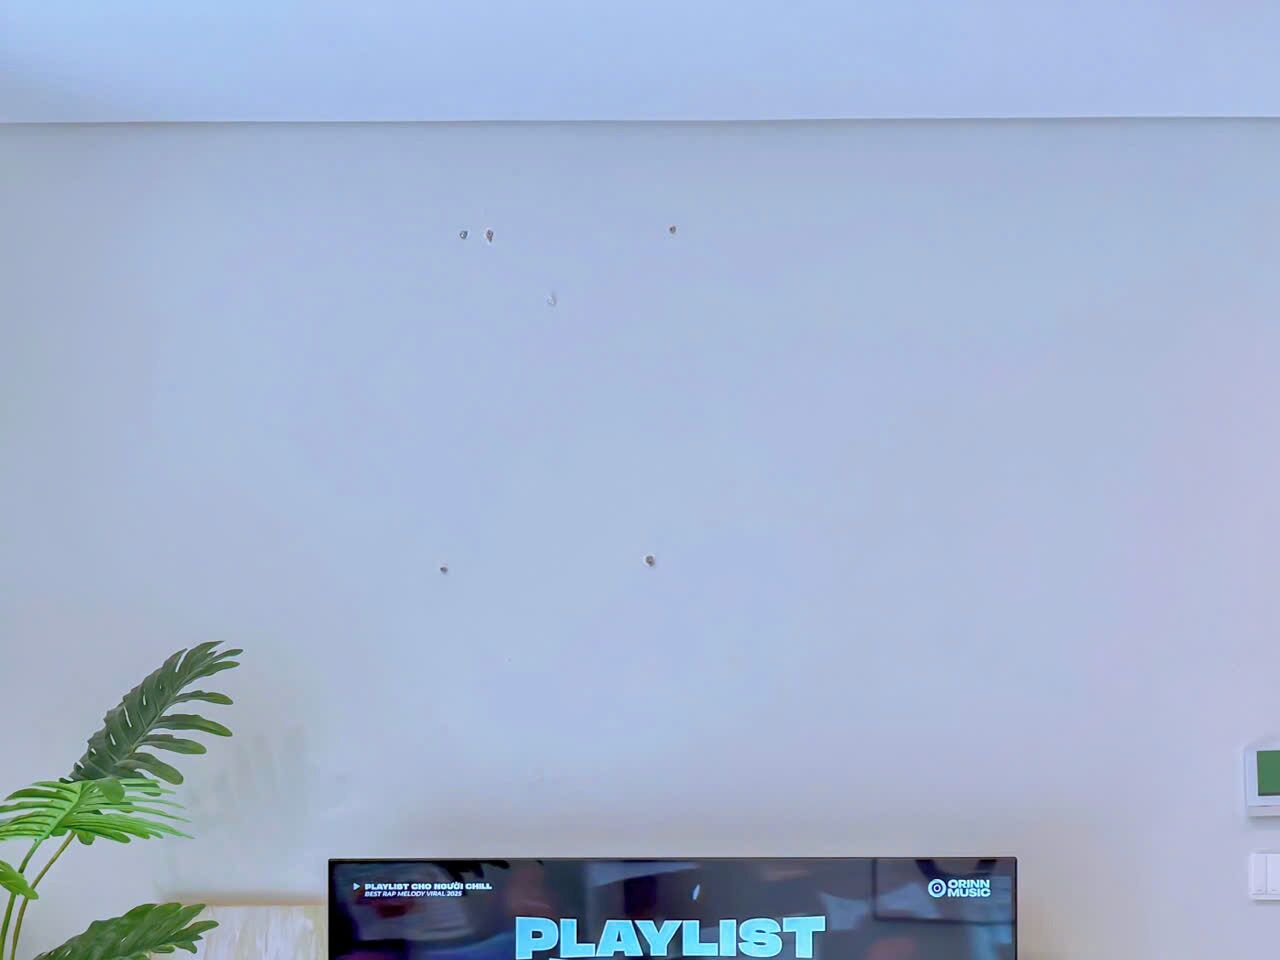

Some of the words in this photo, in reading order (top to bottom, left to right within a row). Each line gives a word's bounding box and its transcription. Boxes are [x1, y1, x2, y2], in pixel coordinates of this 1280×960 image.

[465, 882, 493, 890] CHILL
[947, 879, 990, 888] ORINN
[947, 888, 991, 897] MUSIC
[515, 915, 826, 960] PLAYLIST
